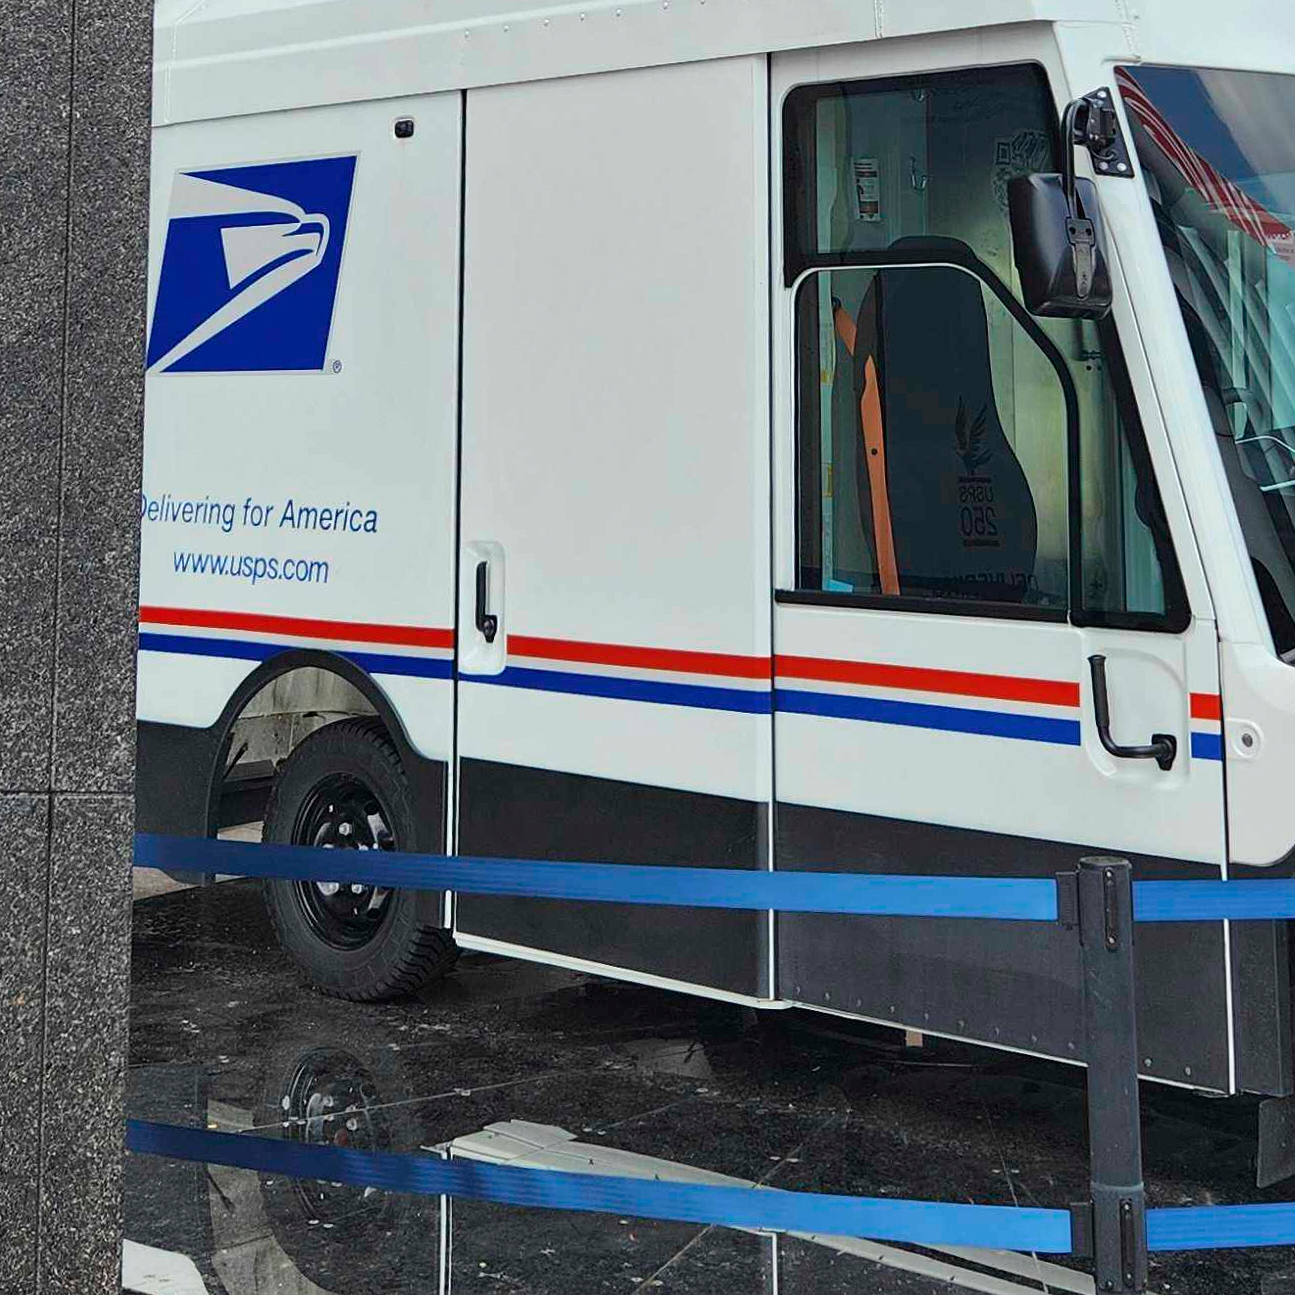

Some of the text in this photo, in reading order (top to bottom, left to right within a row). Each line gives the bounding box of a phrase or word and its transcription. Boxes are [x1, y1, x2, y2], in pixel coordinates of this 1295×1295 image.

[242, 497, 273, 527] for
[279, 499, 378, 533] America
[173, 551, 329, 585] www.usps.com
